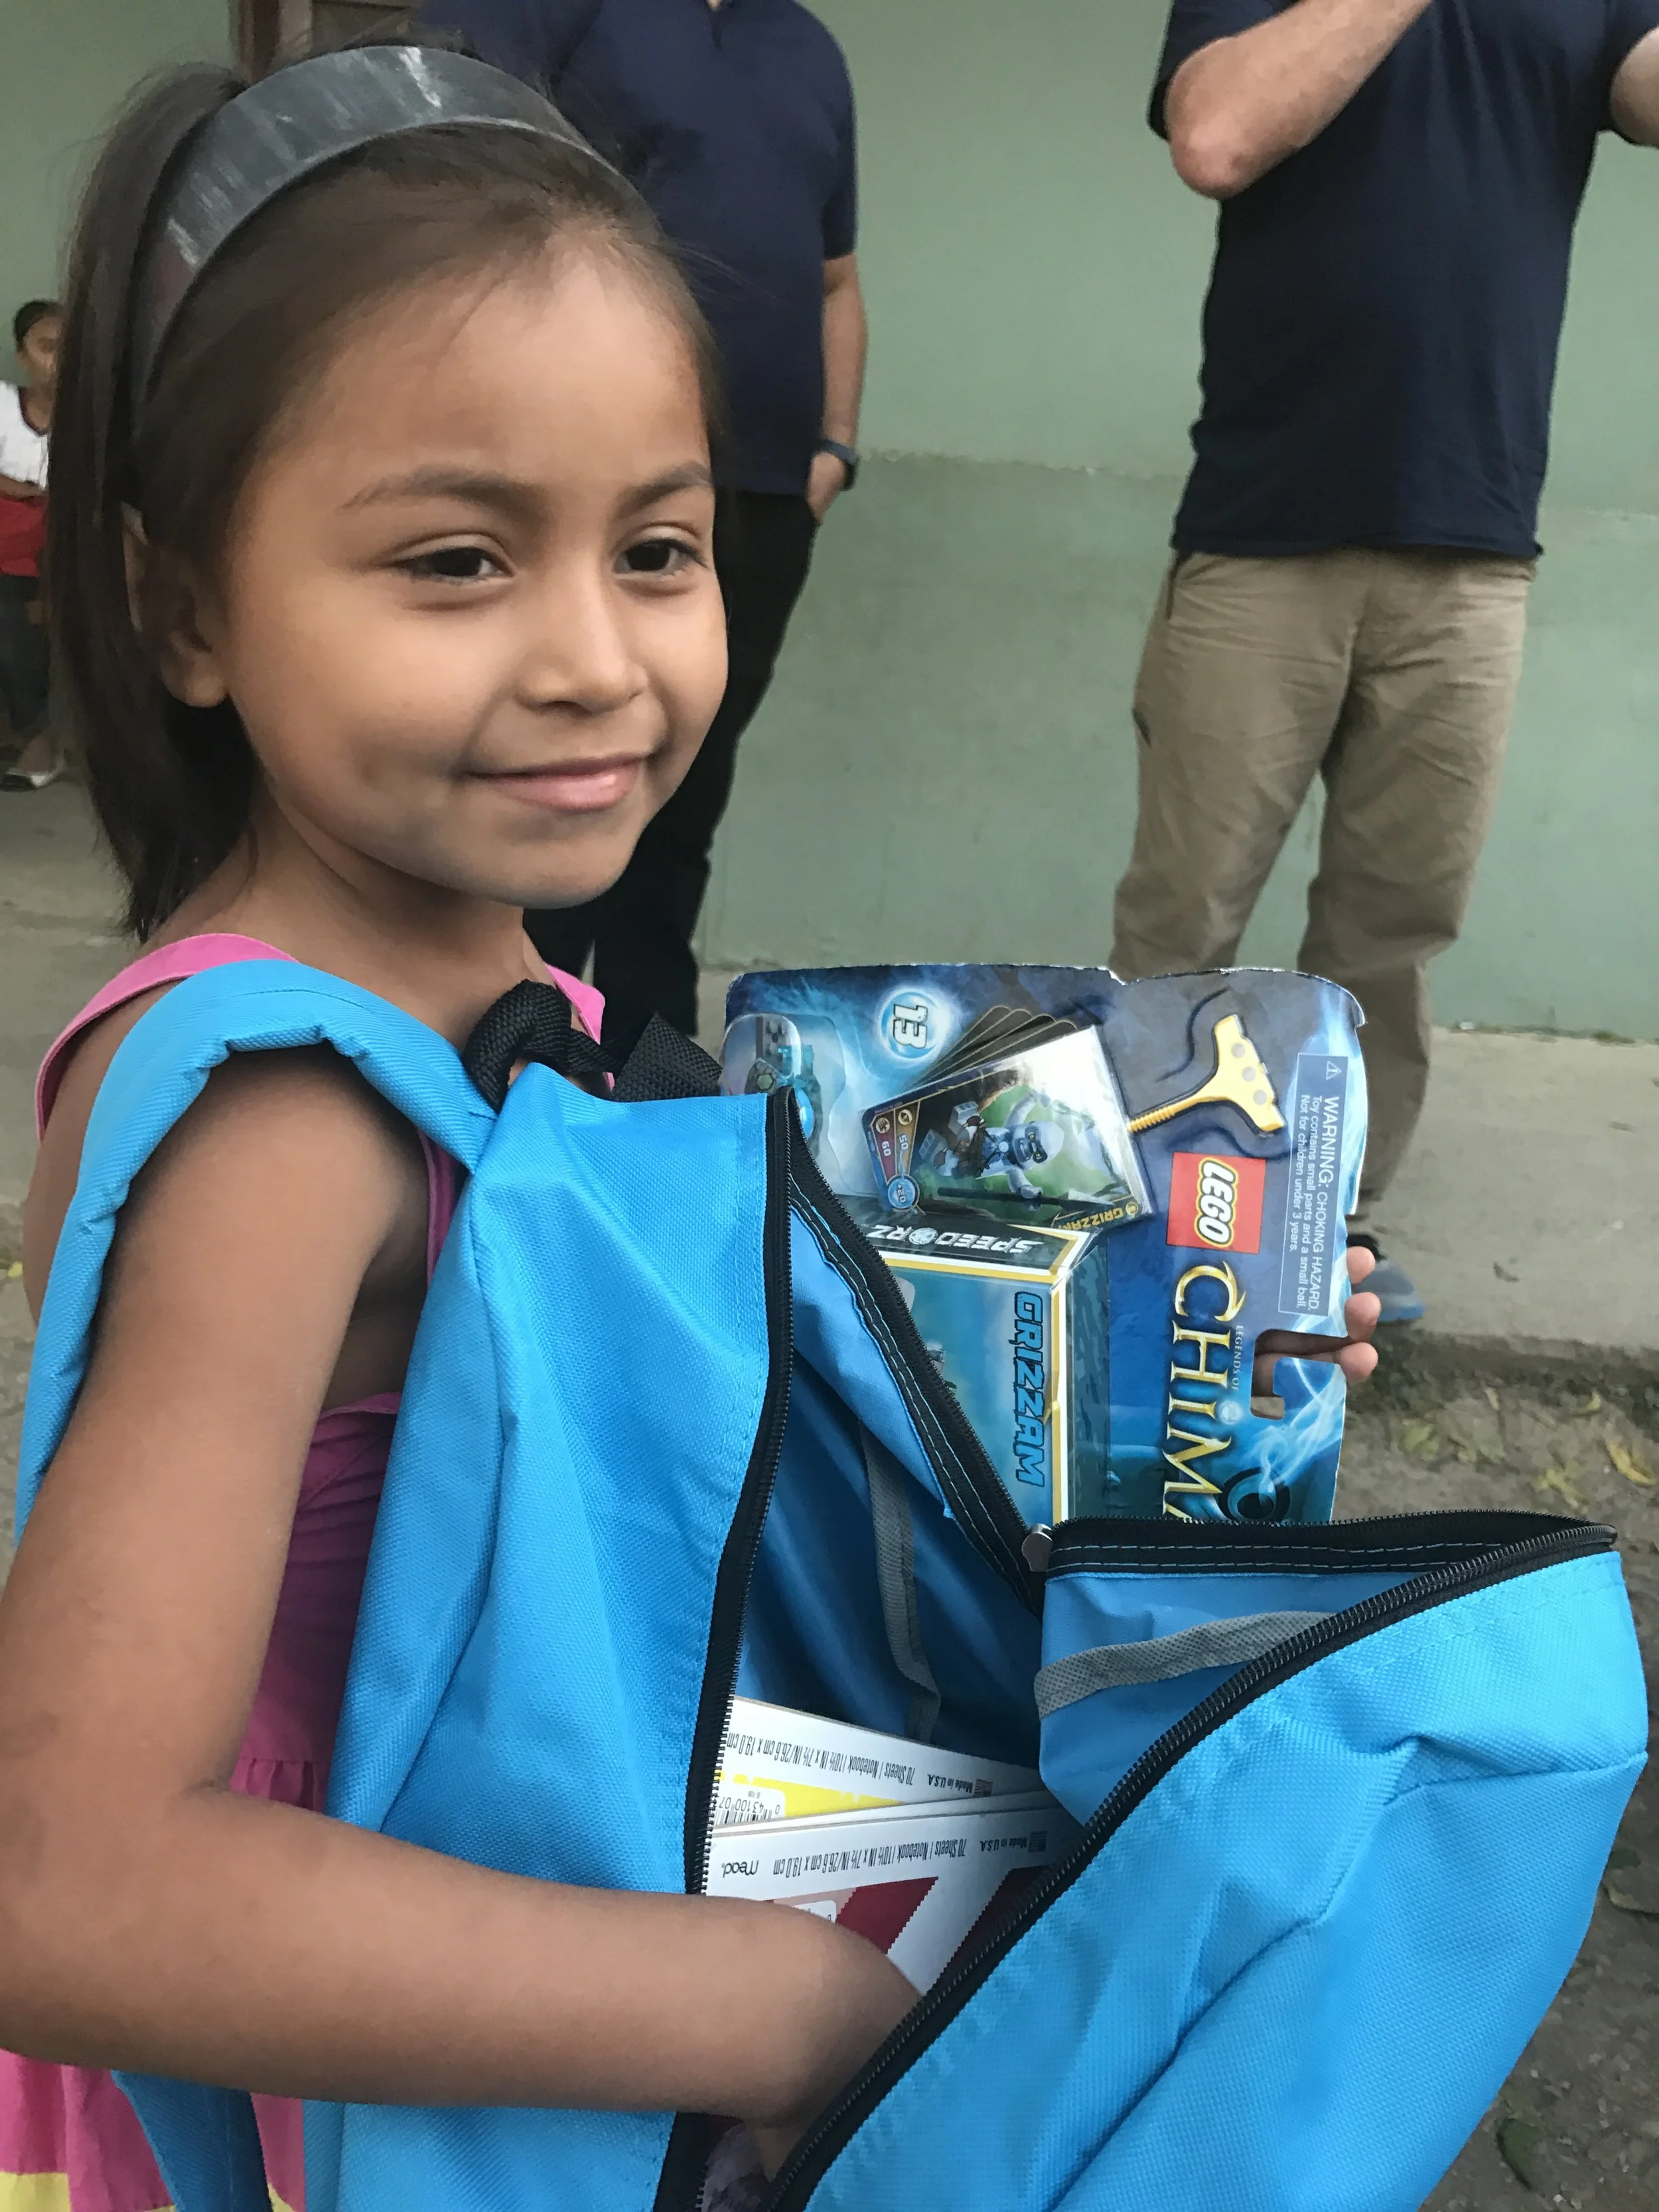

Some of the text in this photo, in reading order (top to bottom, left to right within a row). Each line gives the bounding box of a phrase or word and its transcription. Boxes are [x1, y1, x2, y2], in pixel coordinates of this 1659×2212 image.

[893, 1003, 928, 1049] 13
[1300, 1094, 1311, 1114] Not
[1309, 1096, 1323, 1114] Toy
[1299, 1116, 1309, 1131] for
[899, 1134, 909, 1151] 50
[1308, 1115, 1319, 1161] contains
[881, 1140, 892, 1157] 60
[1295, 1133, 1307, 1175] children
[1306, 1163, 1315, 1191] small
[1196, 1157, 1238, 1246] LEGO
[1293, 1178, 1303, 1211] under
[1307, 1096, 1340, 1311] WARNING: CHOKING HAZARD.
[1304, 1193, 1313, 1221] parts
[1289, 1220, 1299, 1252] years.
[1301, 1223, 1312, 1244] and
[1299, 1256, 1308, 1284] small
[1296, 1287, 1307, 1309] ball.
[1232, 1325, 1244, 1391] LEGENDS OF
[1011, 1291, 1045, 1487] GRIZZAM
[1162, 1261, 1246, 1520] CHIM
[727, 1732, 739, 1749] cm
[739, 1735, 756, 1756] 19.0
[757, 1738, 763, 1753] x
[763, 1739, 776, 1755] cm
[815, 1749, 822, 1763] x
[820, 1750, 830, 1769] IN
[847, 1756, 879, 1779] Notebook
[884, 1763, 906, 1783] Sheets
[906, 1767, 916, 1785] 70
[927, 1774, 974, 1793] Made in U.S.A.
[735, 1799, 764, 1813] 43100
[775, 1805, 780, 1814] 0
[897, 1842, 929, 1864] Notebook
[934, 1839, 956, 1858] Sheets
[957, 1838, 968, 1857] 70
[1001, 1838, 1007, 1848] in
[1008, 1837, 1028, 1849] Made
[804, 1856, 810, 1871] x
[810, 1854, 822, 1870] cm
[863, 1848, 869, 1864] x
[868, 1847, 877, 1867] IN
[773, 1858, 786, 1875] cm
[785, 1857, 803, 1878] 19.0
